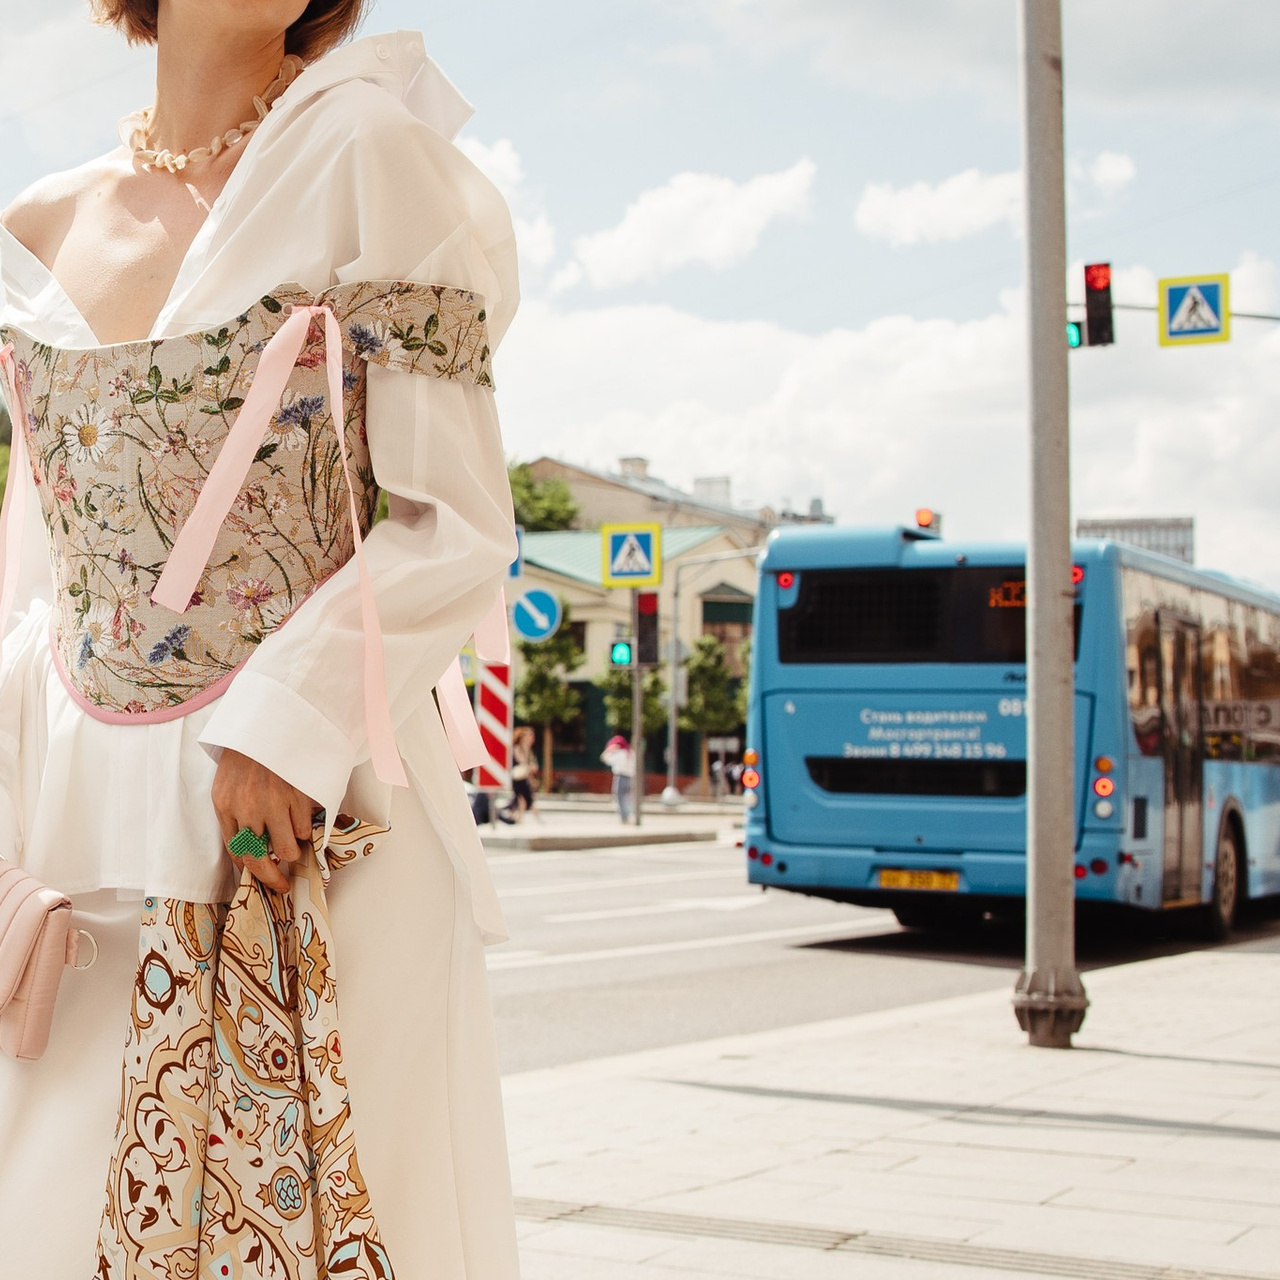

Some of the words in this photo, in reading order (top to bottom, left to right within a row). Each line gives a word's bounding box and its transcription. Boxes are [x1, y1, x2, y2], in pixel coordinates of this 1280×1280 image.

[860, 708, 904, 724] Стань
[905, 710, 988, 725] водителем
[843, 743, 888, 758] Звони
